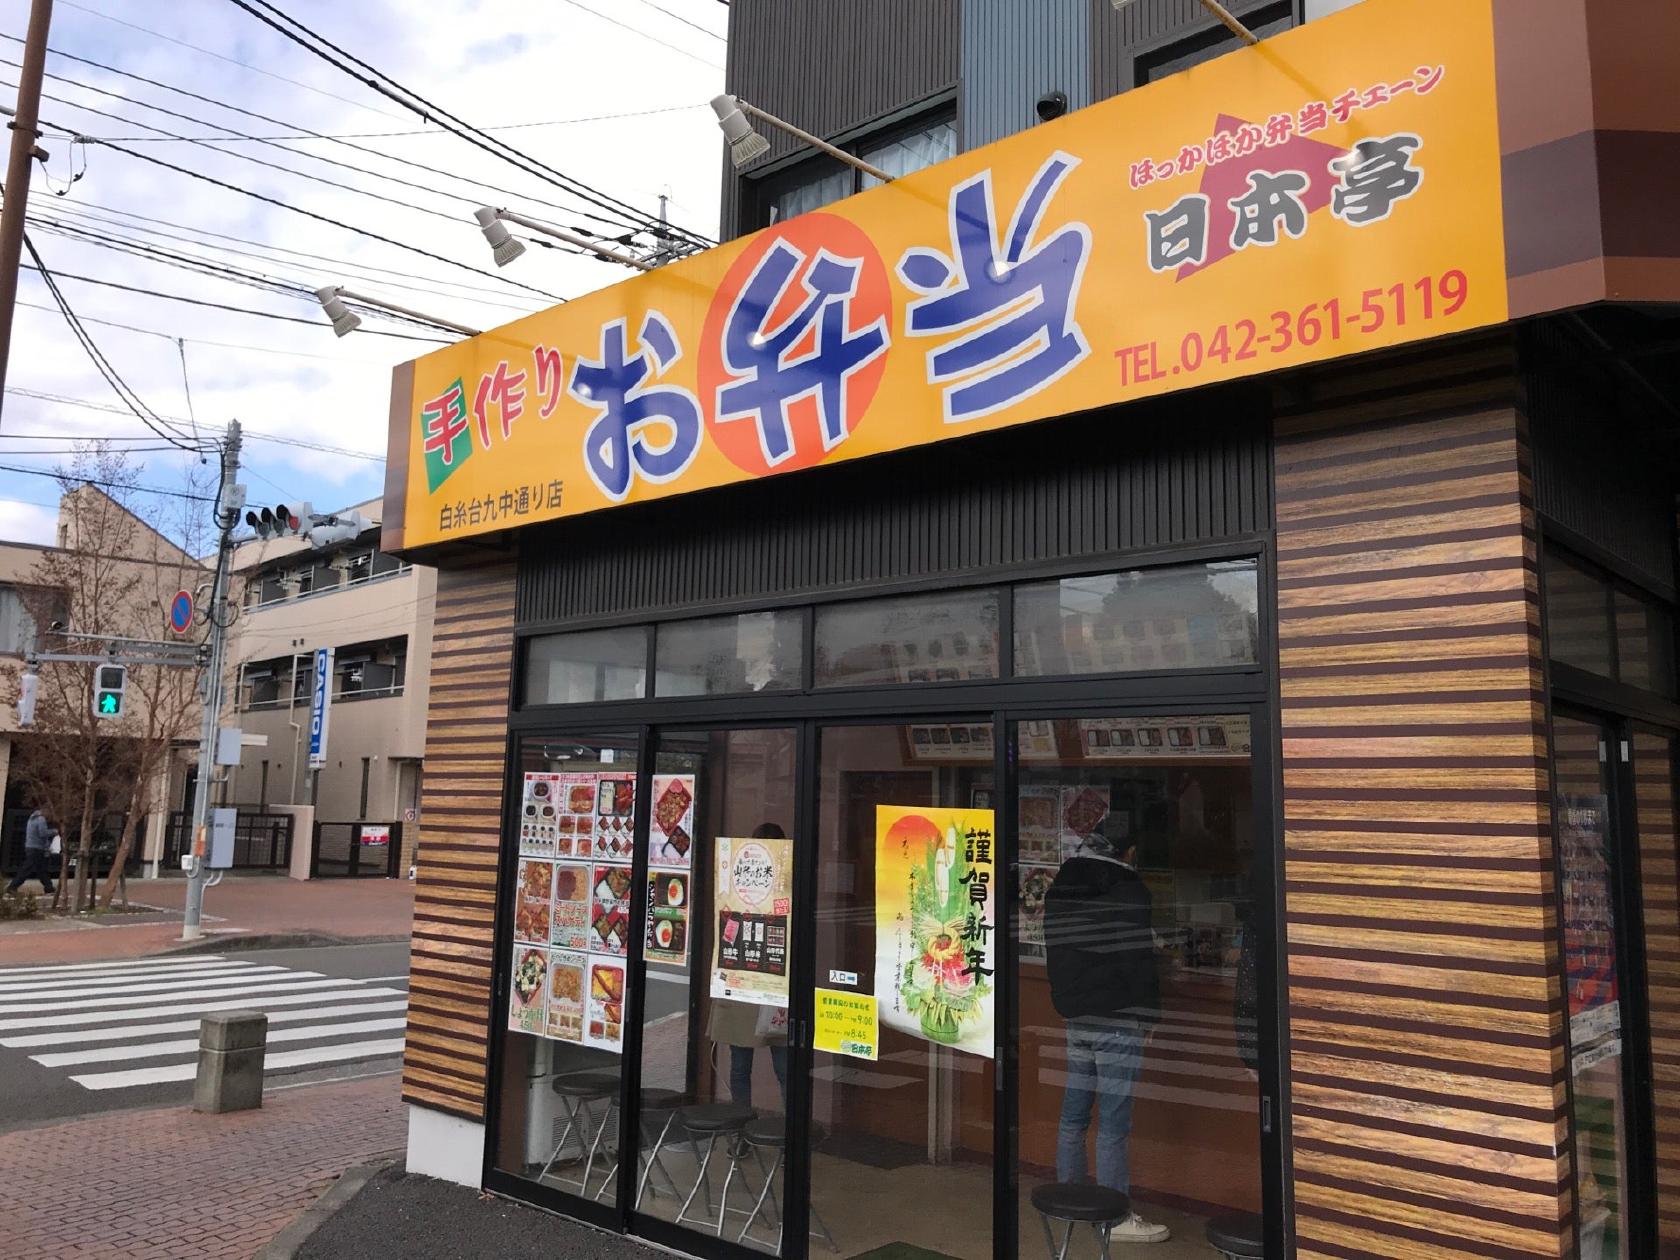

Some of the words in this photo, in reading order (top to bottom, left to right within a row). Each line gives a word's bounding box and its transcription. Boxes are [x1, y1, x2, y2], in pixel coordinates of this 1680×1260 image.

[1129, 65, 1444, 189] ほっかほか弁当チェーン
[1144, 132, 1424, 274] 日本亭
[421, 343, 564, 465] 手作り
[566, 150, 1093, 501] お弁当
[1114, 269, 1468, 387] TEL.042-361-5119
[440, 479, 563, 531] 白糸台九中通り店
[312, 653, 326, 735] CASIO
[959, 827, 995, 985] 謹賀新年
[831, 971, 846, 982] 入口
